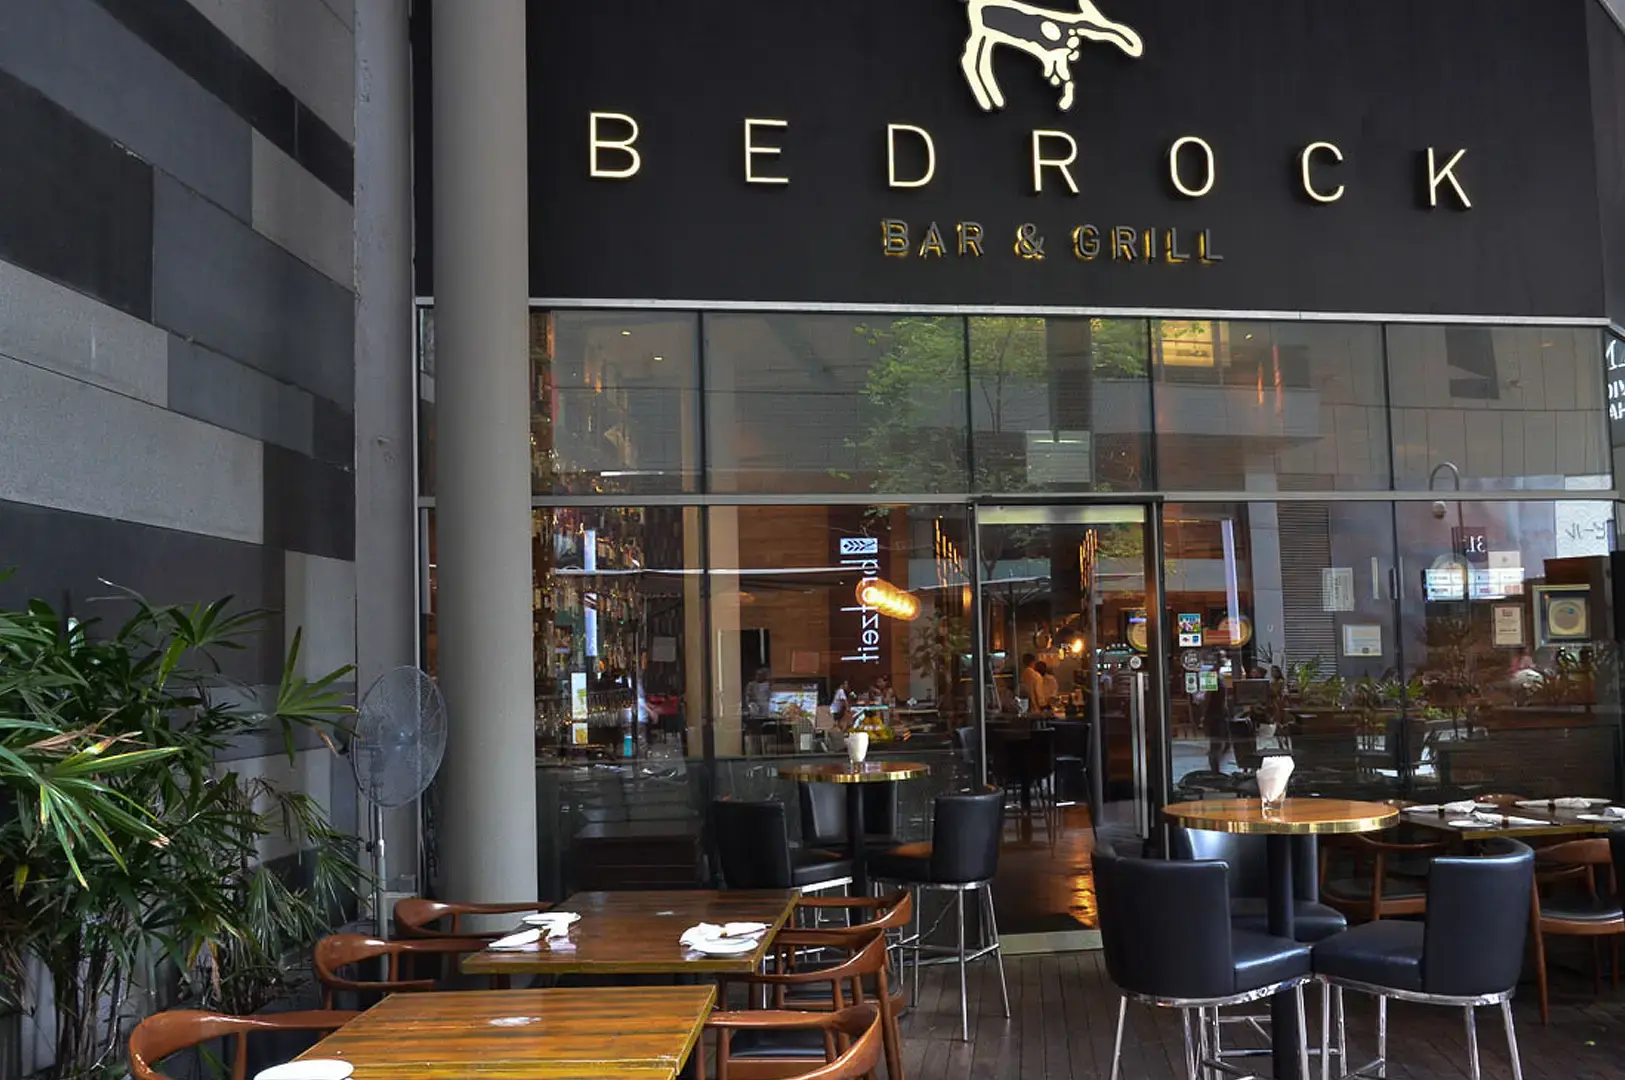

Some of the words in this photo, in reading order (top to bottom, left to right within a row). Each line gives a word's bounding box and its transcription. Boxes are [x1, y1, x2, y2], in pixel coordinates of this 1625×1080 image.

[589, 111, 1473, 210] BEDROCK
[880, 219, 985, 259] BAR
[1014, 223, 1046, 261] &
[1072, 224, 1224, 265] GRILL
